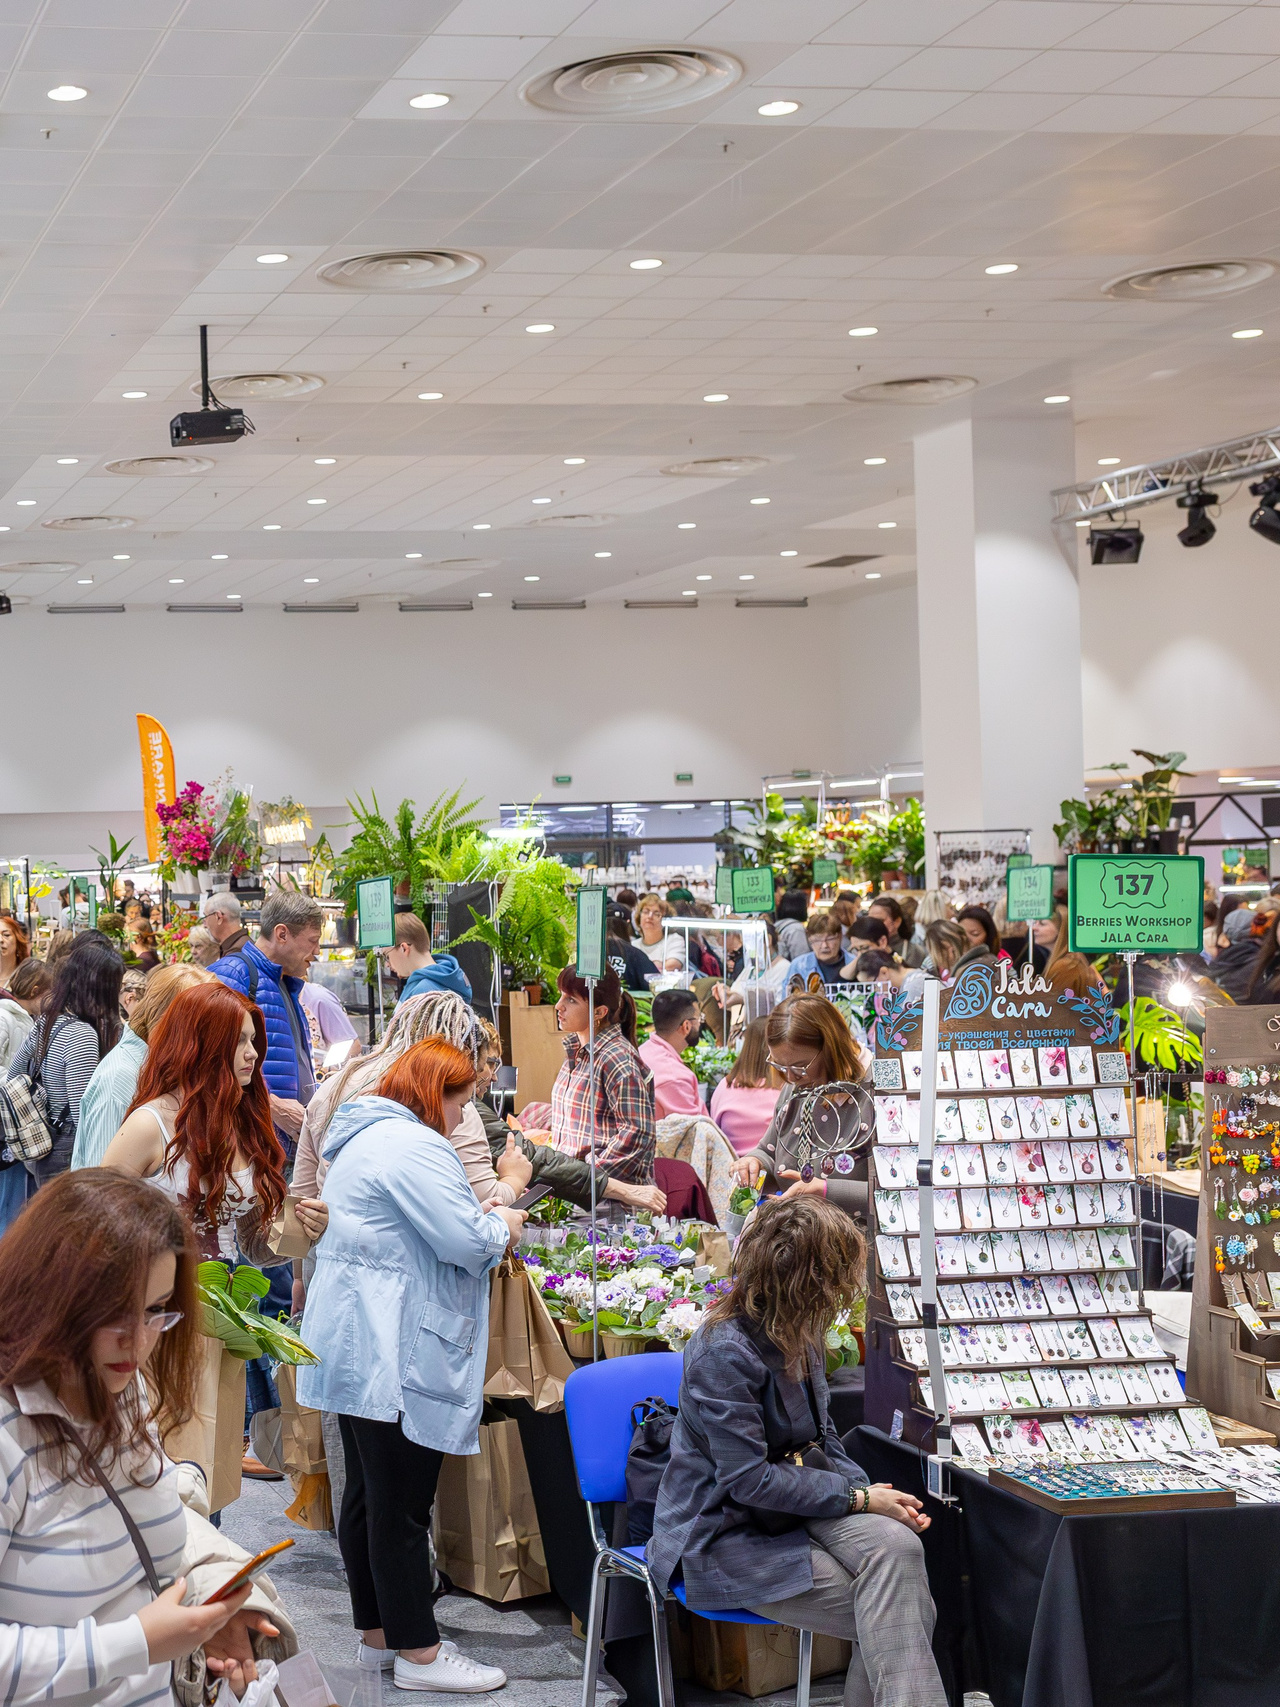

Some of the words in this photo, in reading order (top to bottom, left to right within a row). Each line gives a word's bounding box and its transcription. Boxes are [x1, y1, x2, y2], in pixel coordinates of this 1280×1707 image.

[746, 876, 760, 887] 133
[1024, 876, 1038, 889] 134
[1114, 874, 1155, 895] 137
[992, 957, 1053, 996] Jala
[991, 996, 1053, 1019] Cara
[938, 1030, 1009, 1041] т-украшения
[1026, 1028, 1076, 1039] цветами
[938, 1041, 951, 1050] ля
[956, 1039, 995, 1050] твоей
[1001, 1037, 1070, 1049] Вселенной
